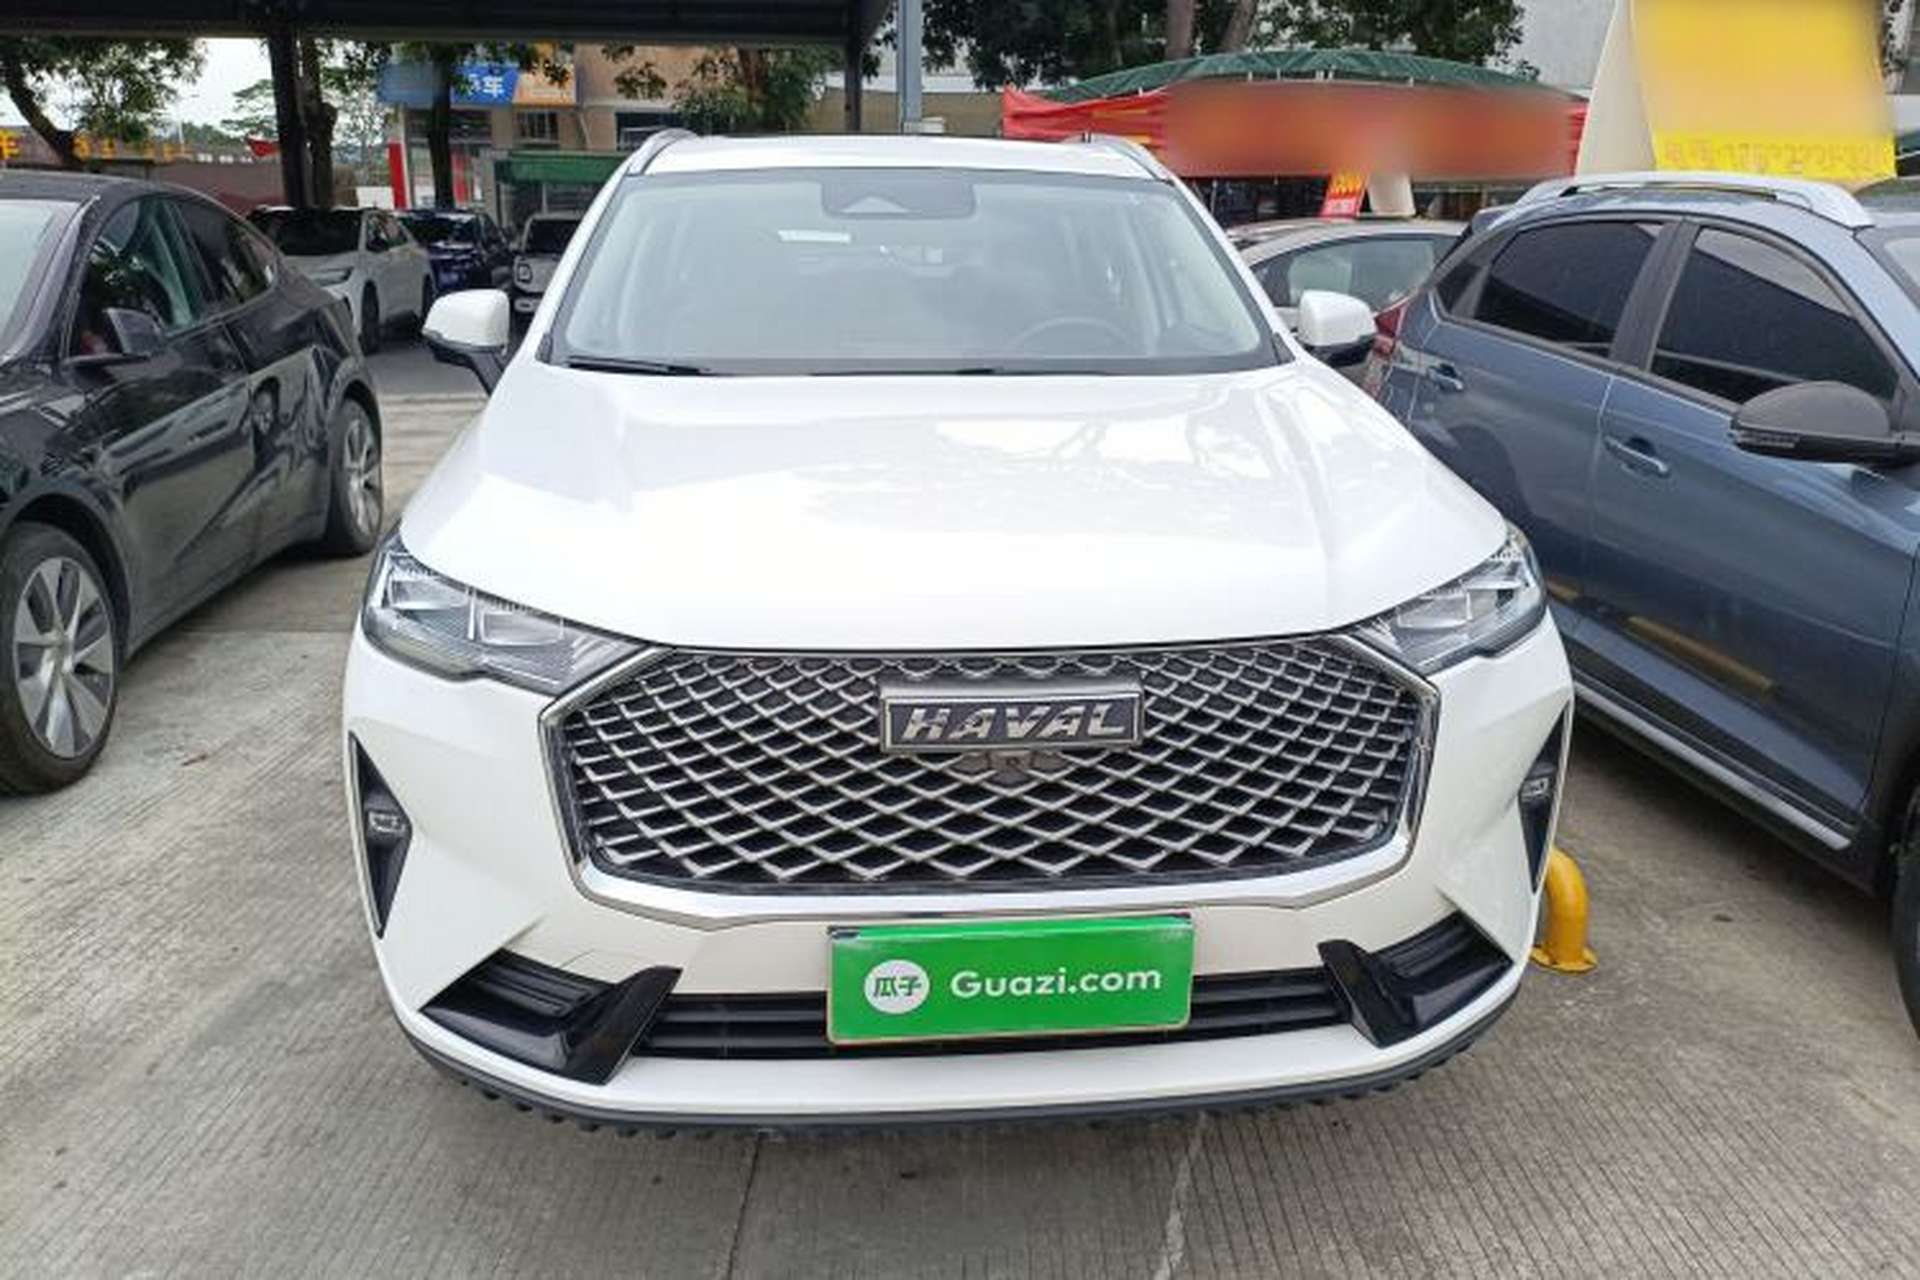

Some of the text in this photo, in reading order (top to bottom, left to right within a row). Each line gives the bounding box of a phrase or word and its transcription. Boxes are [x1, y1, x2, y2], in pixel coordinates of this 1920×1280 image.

[902, 703, 1127, 740] HAVAL
[873, 975, 922, 998] 瓜子
[950, 966, 1162, 999] Guazi.com
